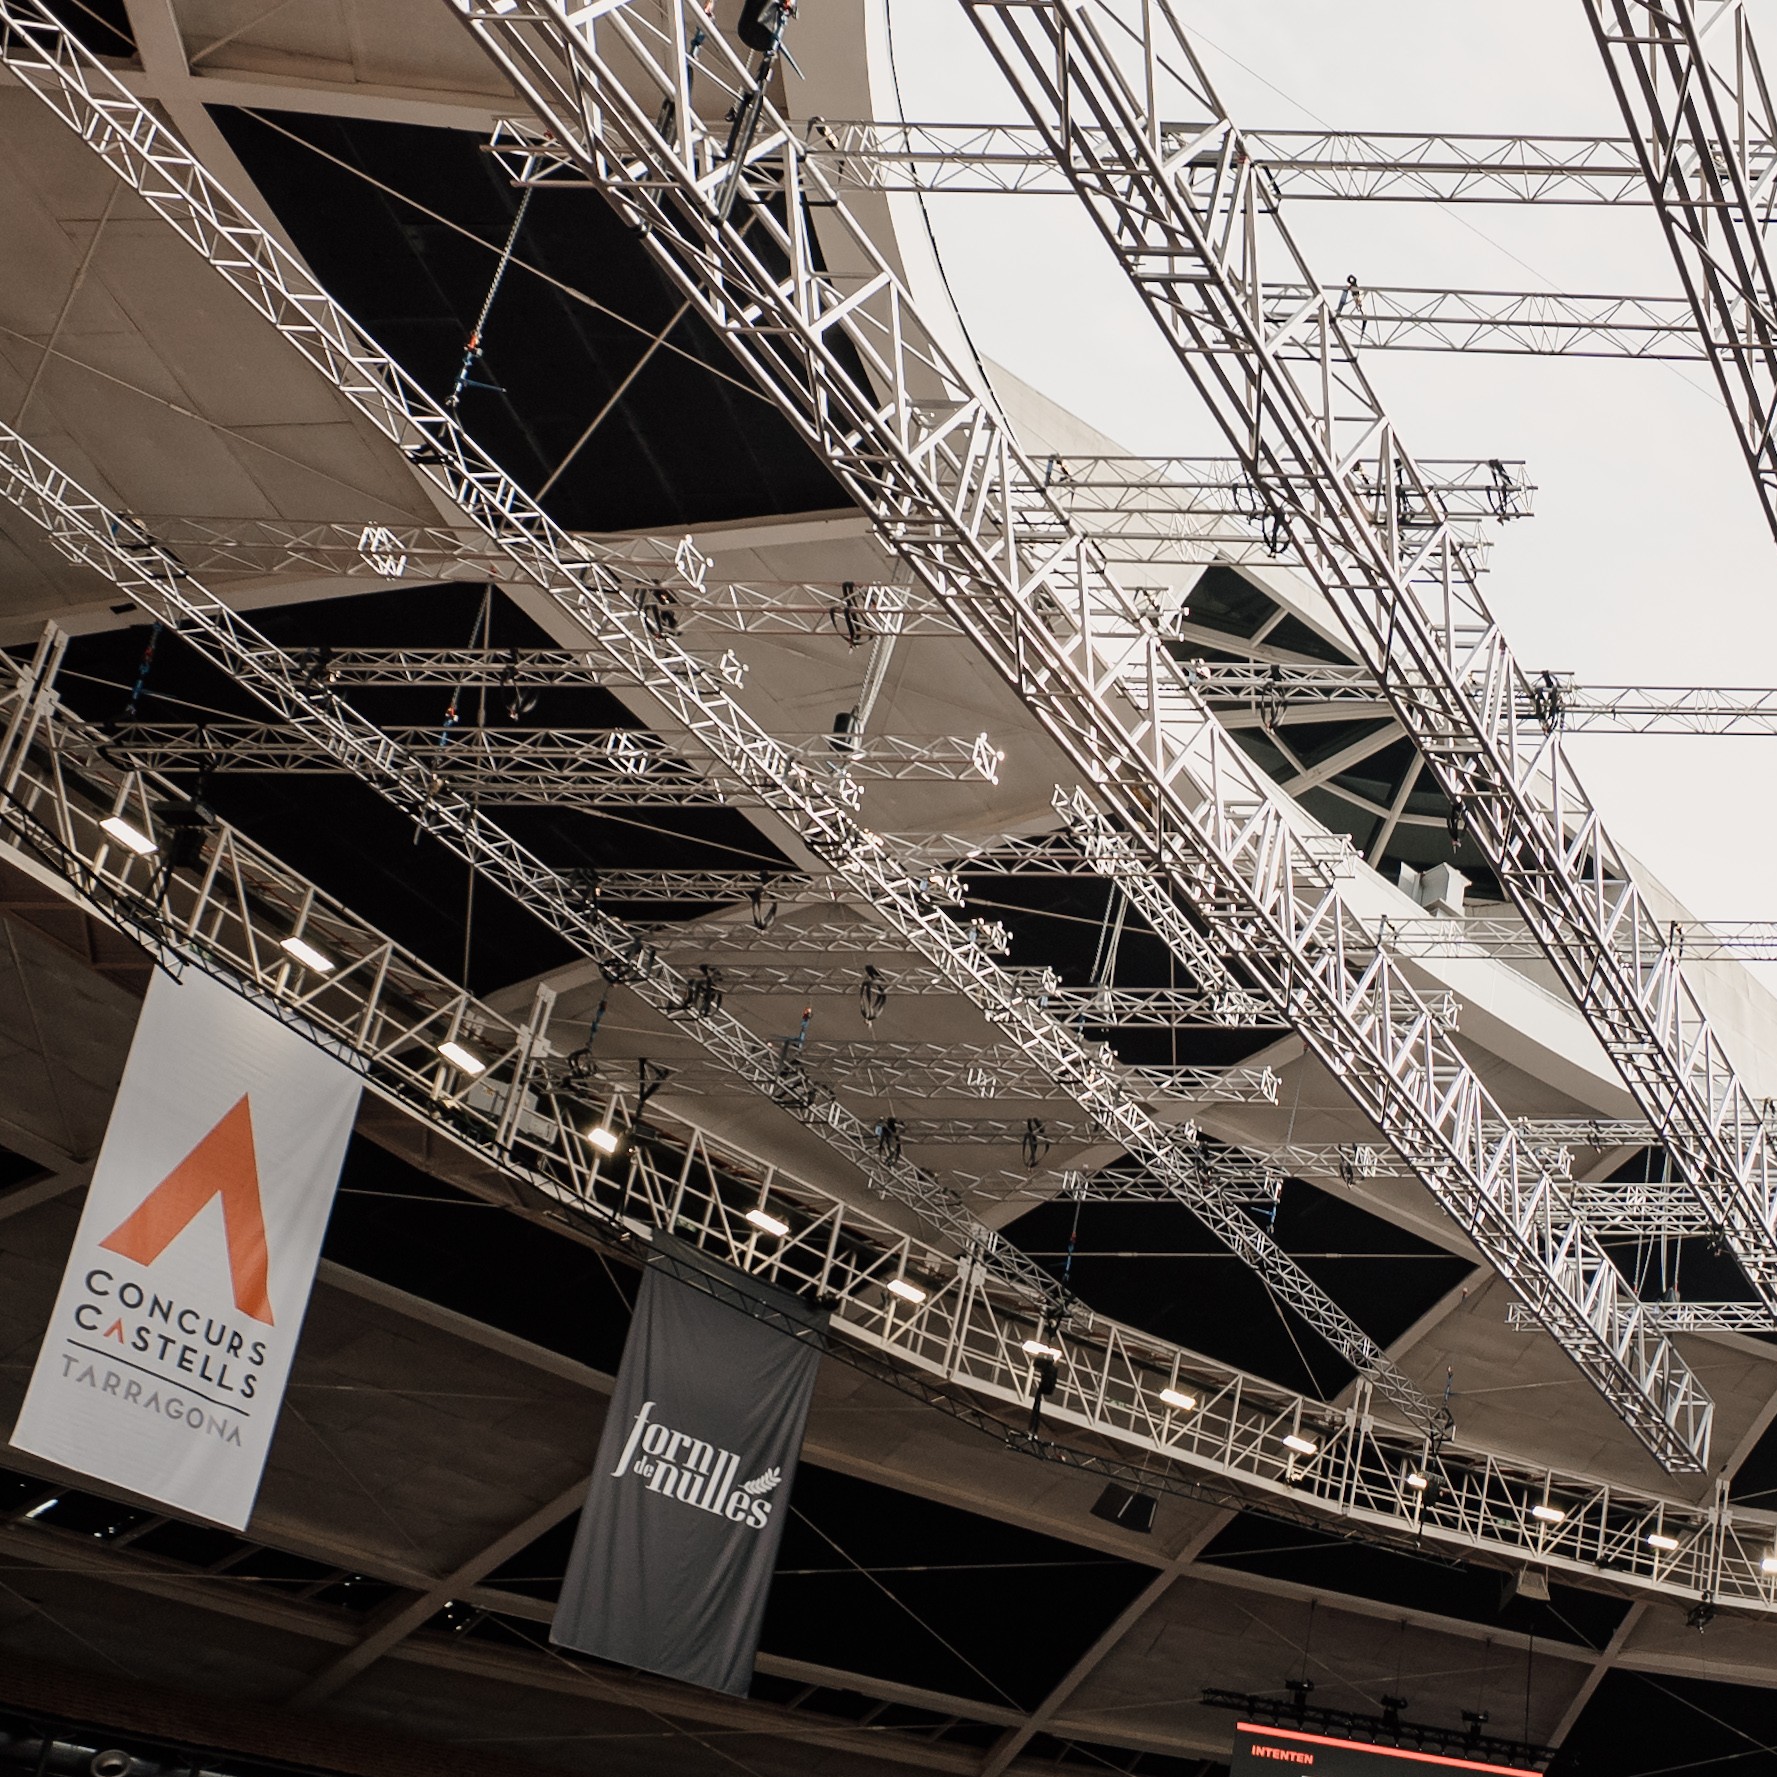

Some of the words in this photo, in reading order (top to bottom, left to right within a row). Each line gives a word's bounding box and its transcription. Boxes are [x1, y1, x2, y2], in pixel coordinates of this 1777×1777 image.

[75, 1304, 258, 1399] CASTELLS
[85, 1269, 267, 1366] CONCURS
[62, 1353, 242, 1447] TARRAGONA
[610, 1401, 715, 1478] forn
[633, 1455, 655, 1478] de
[645, 1448, 773, 1529] nulles
[1252, 1744, 1314, 1766] INTENTEN
